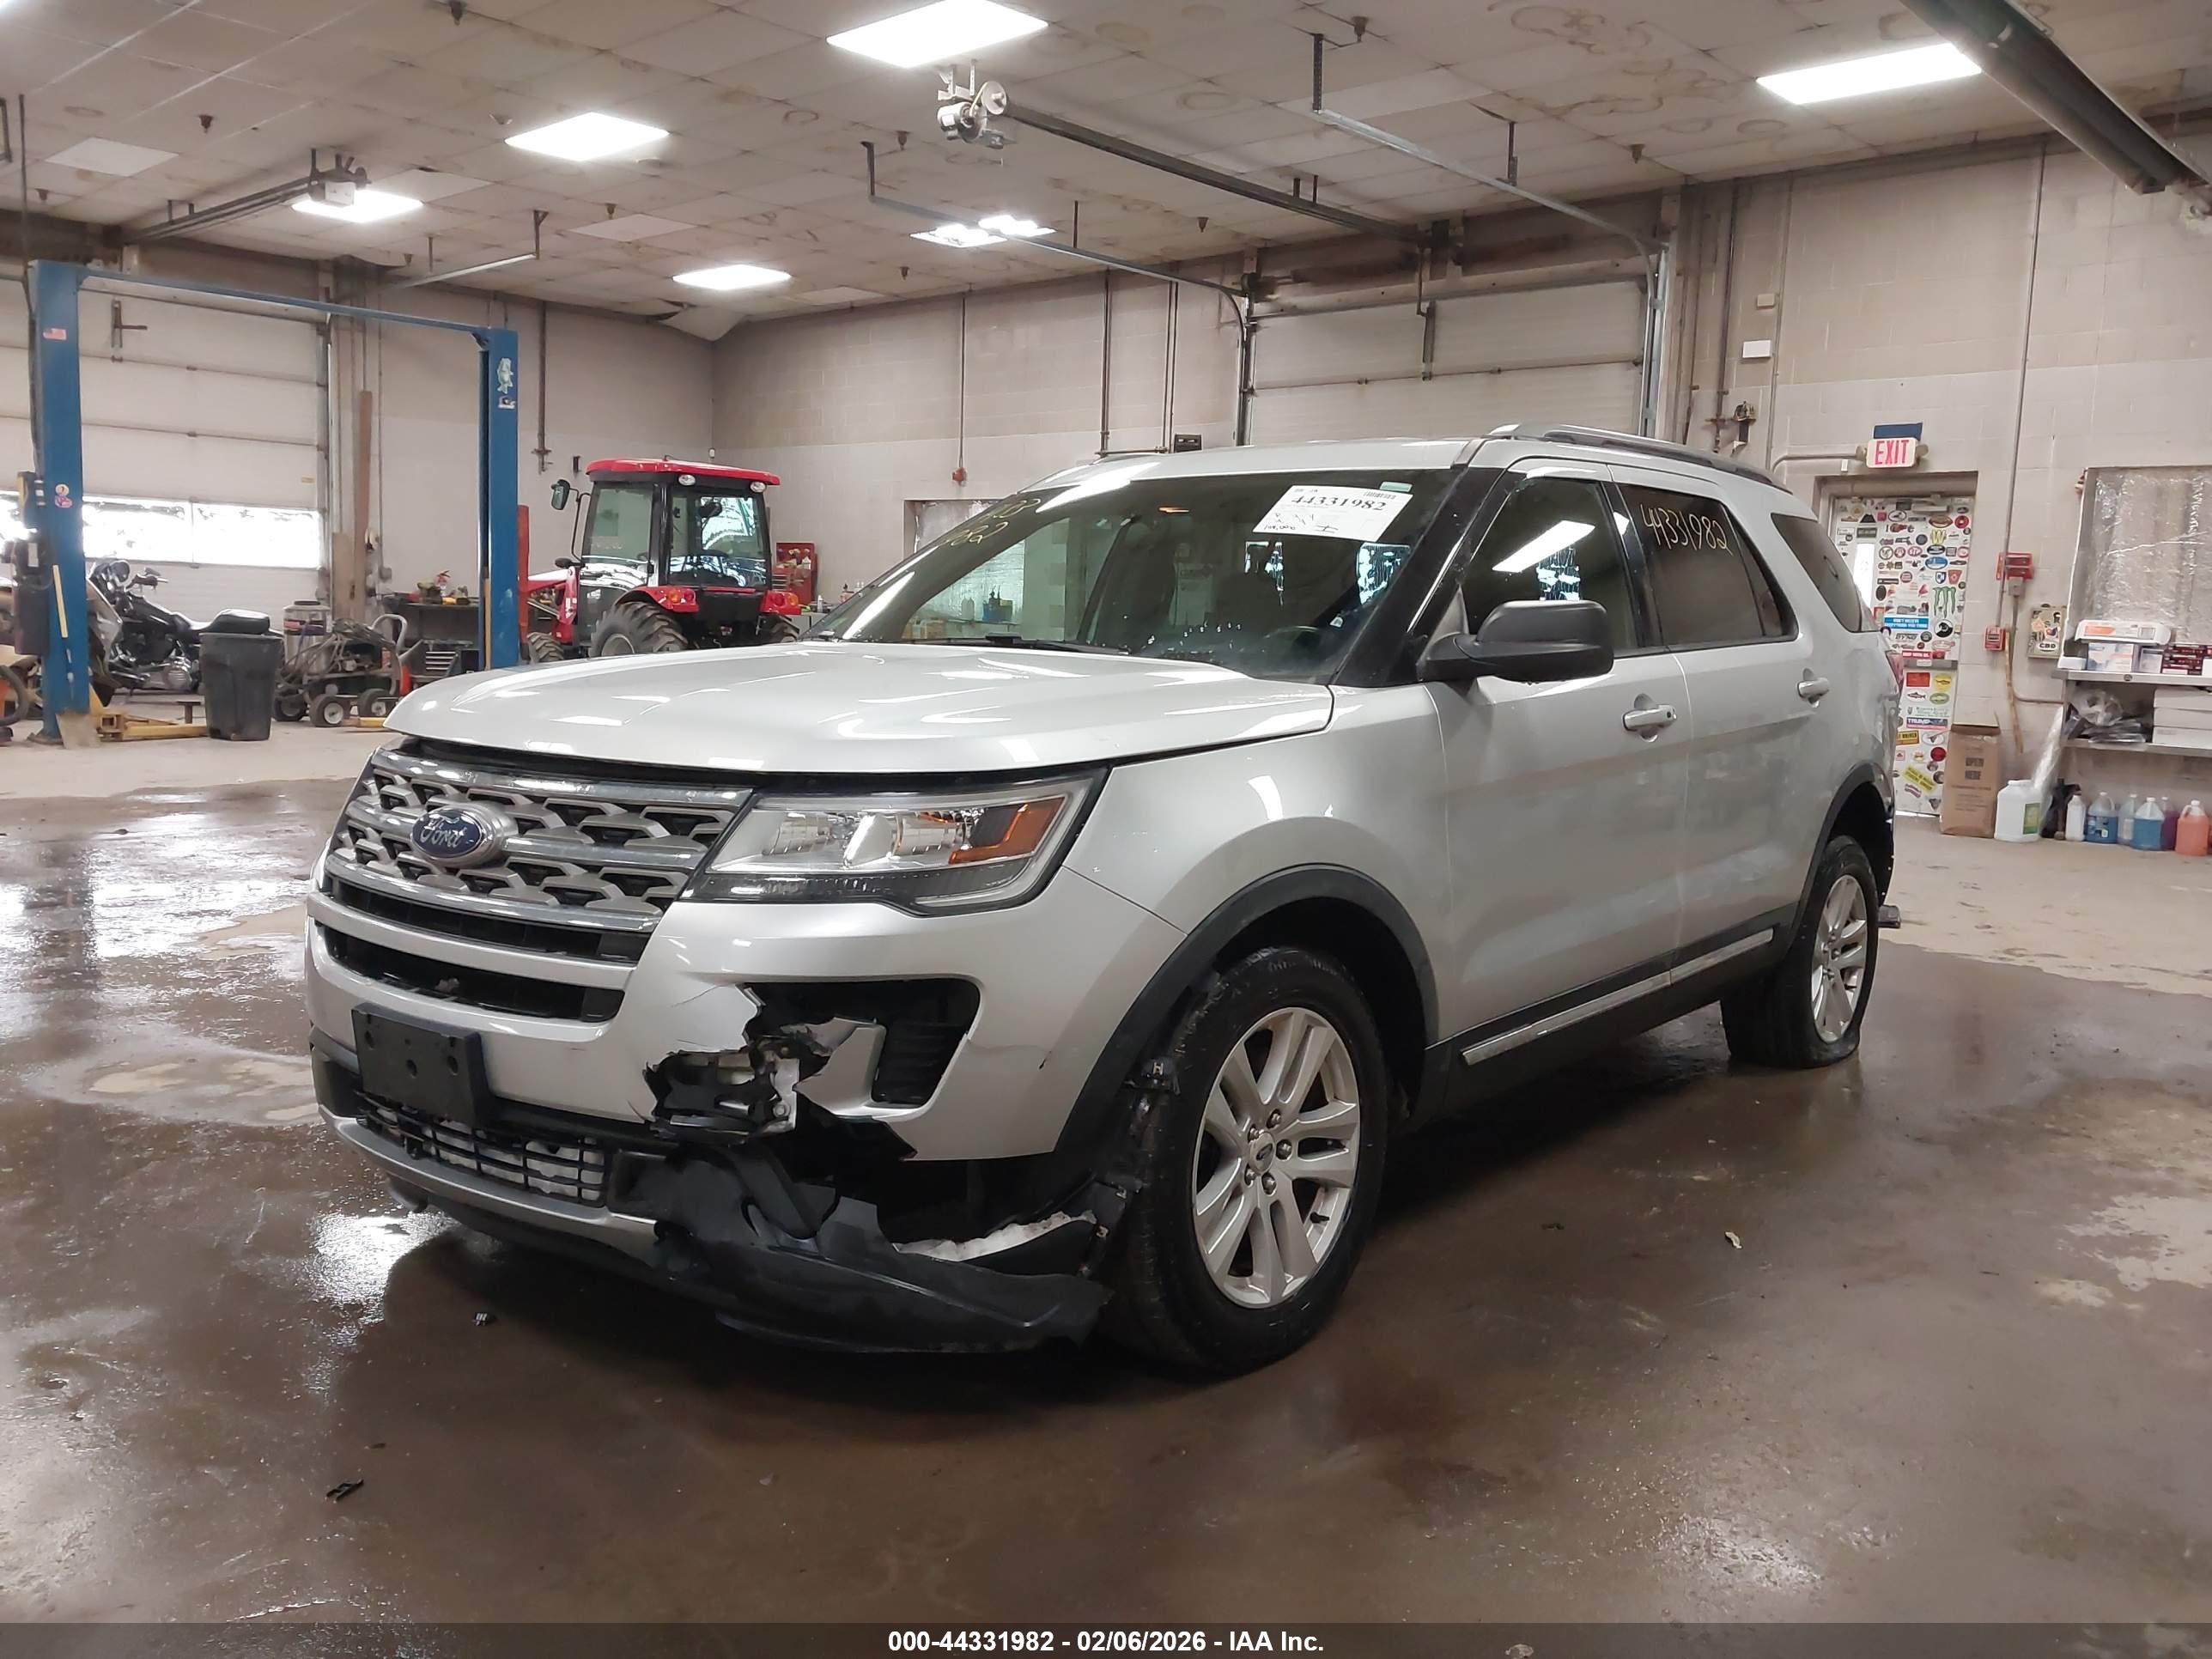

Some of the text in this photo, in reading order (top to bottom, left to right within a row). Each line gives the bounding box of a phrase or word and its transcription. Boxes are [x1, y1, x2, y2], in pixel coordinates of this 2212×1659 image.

[1875, 439, 1910, 465] EXIT
[1291, 495, 1388, 511] 44331982
[1639, 503, 1734, 557] 44331982
[419, 816, 469, 848] Ford
